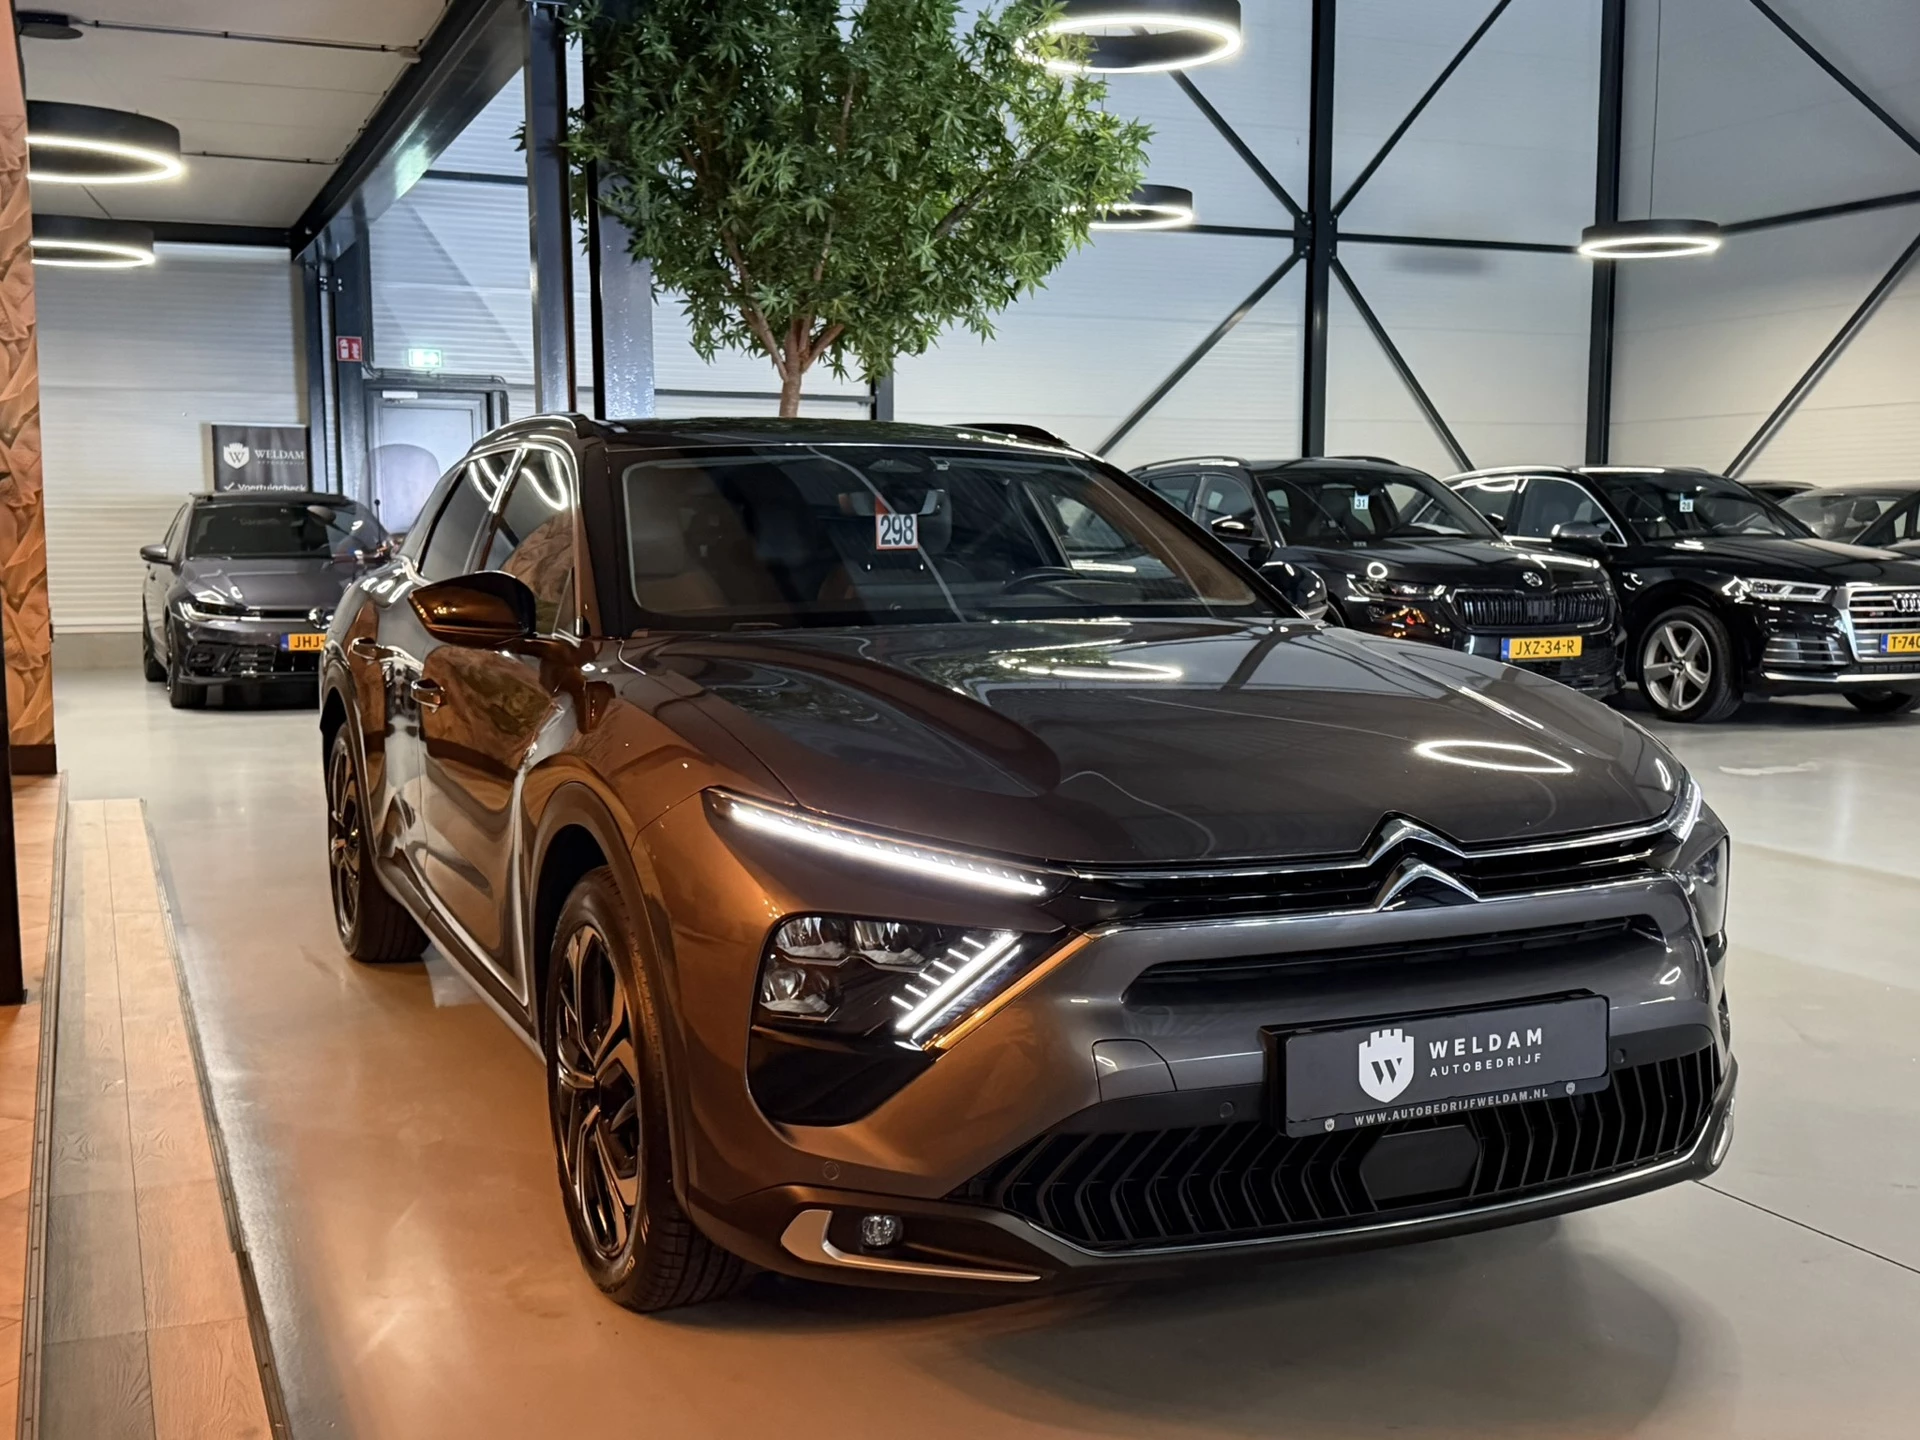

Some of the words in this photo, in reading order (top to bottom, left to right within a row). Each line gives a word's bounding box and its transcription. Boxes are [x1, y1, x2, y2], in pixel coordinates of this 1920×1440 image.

[254, 449, 305, 460] WELDAM
[880, 514, 914, 545] 298
[1515, 640, 1575, 655] JXZ-34-R
[1429, 1027, 1543, 1059] WELDAM
[1371, 1057, 1403, 1086] W
[1430, 1052, 1543, 1077] AUTOBEDRIJF
[1354, 1088, 1549, 1126] WWW.AUTOBEDRIJFWELDAM.NL
